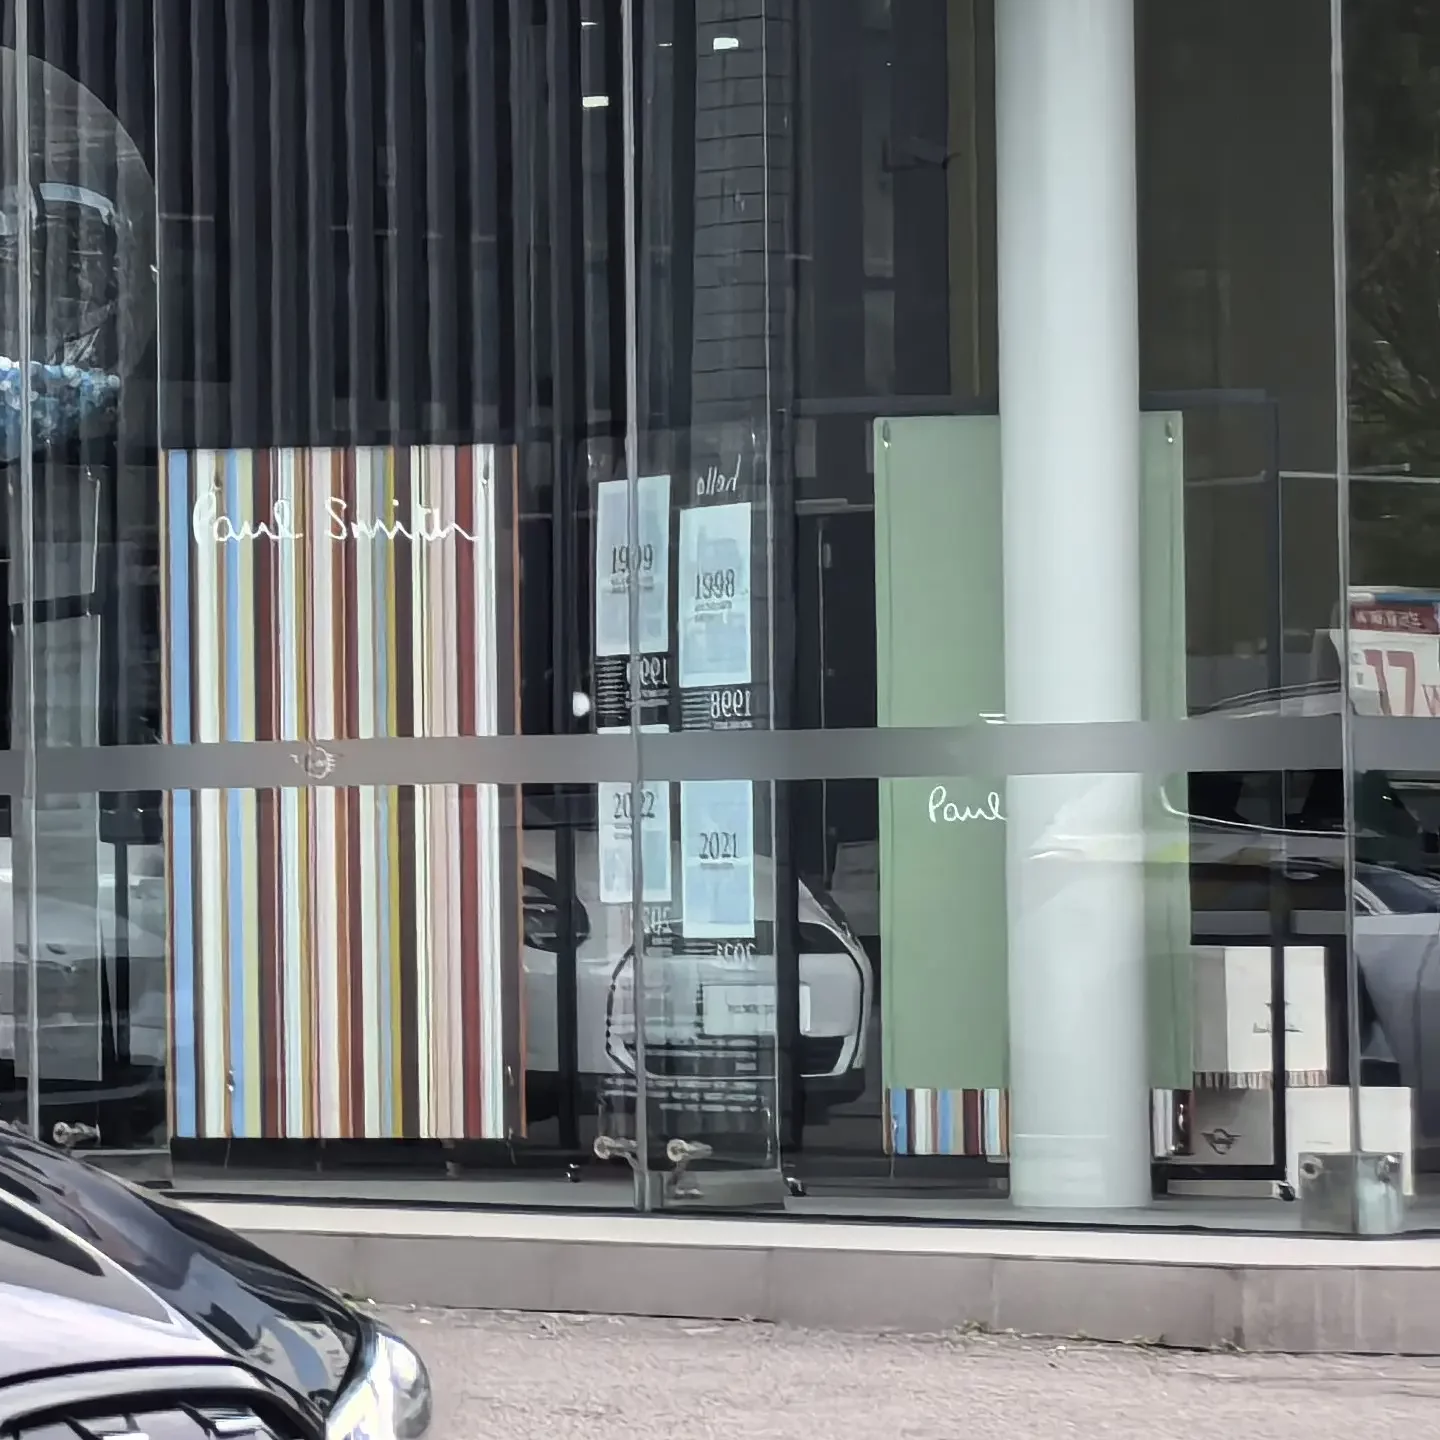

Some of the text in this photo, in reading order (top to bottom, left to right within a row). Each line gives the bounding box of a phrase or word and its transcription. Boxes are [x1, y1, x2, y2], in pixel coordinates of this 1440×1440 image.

[192, 492, 480, 547] Paul Smith
[929, 785, 1008, 823] Paul
[699, 832, 741, 860] 2021
